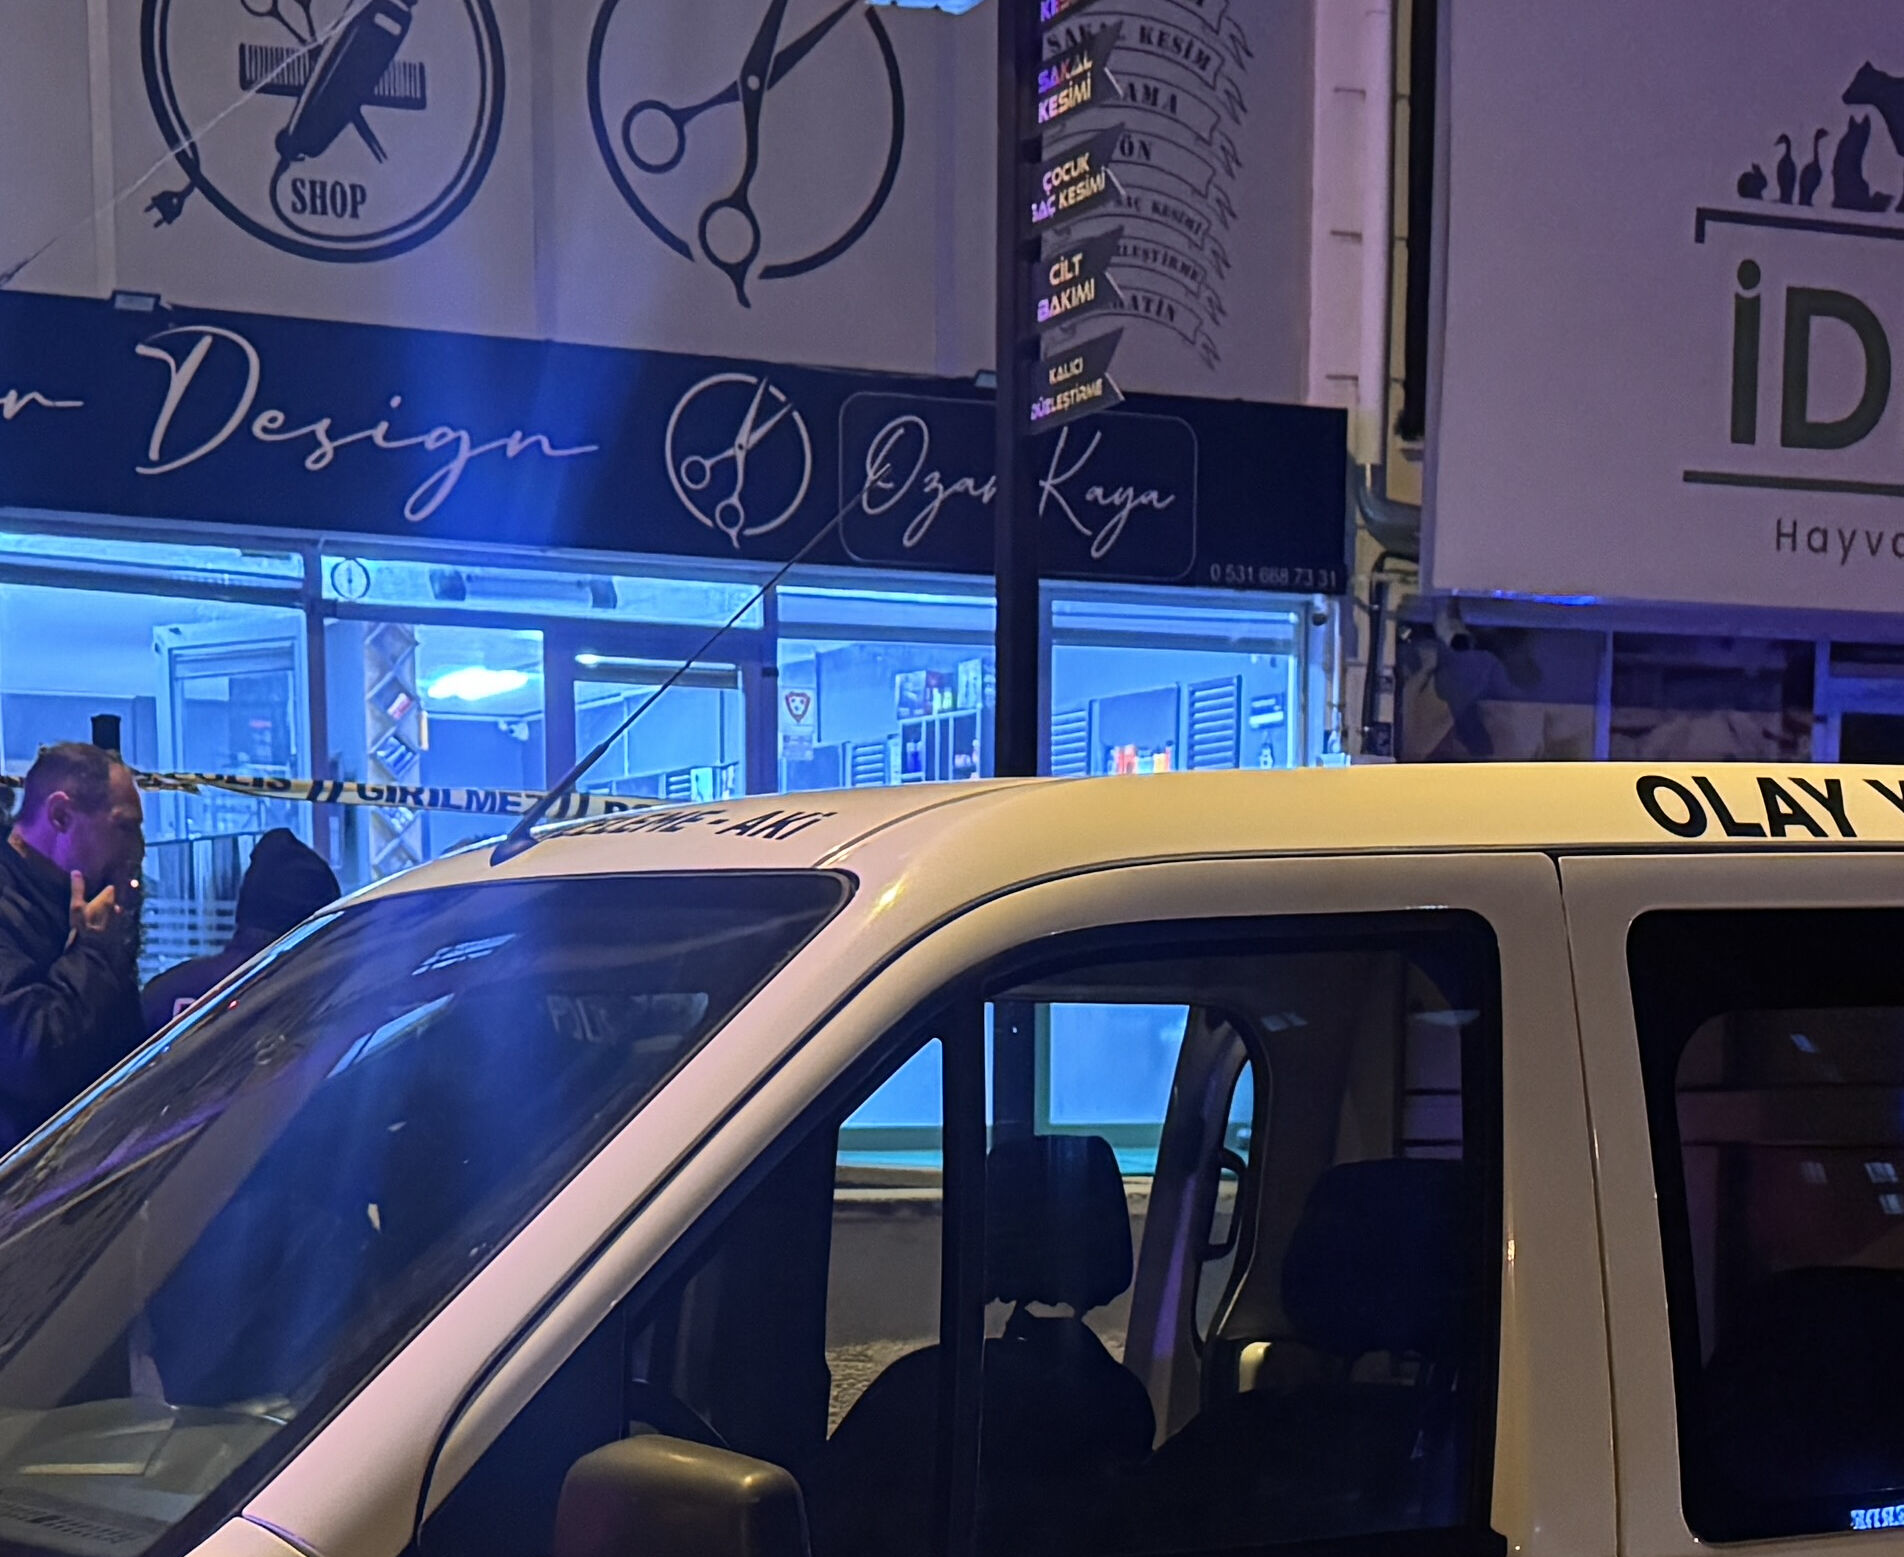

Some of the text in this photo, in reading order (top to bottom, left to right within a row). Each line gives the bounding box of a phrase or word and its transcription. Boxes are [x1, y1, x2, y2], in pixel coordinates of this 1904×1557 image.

[290, 176, 368, 220] SHOP
[1042, 152, 1091, 196] ÇOCUK
[1048, 252, 1084, 286] CİLT
[134, 324, 600, 523] Design
[1038, 425, 1176, 559] Kaya
[1635, 775, 1858, 839] OLAY
